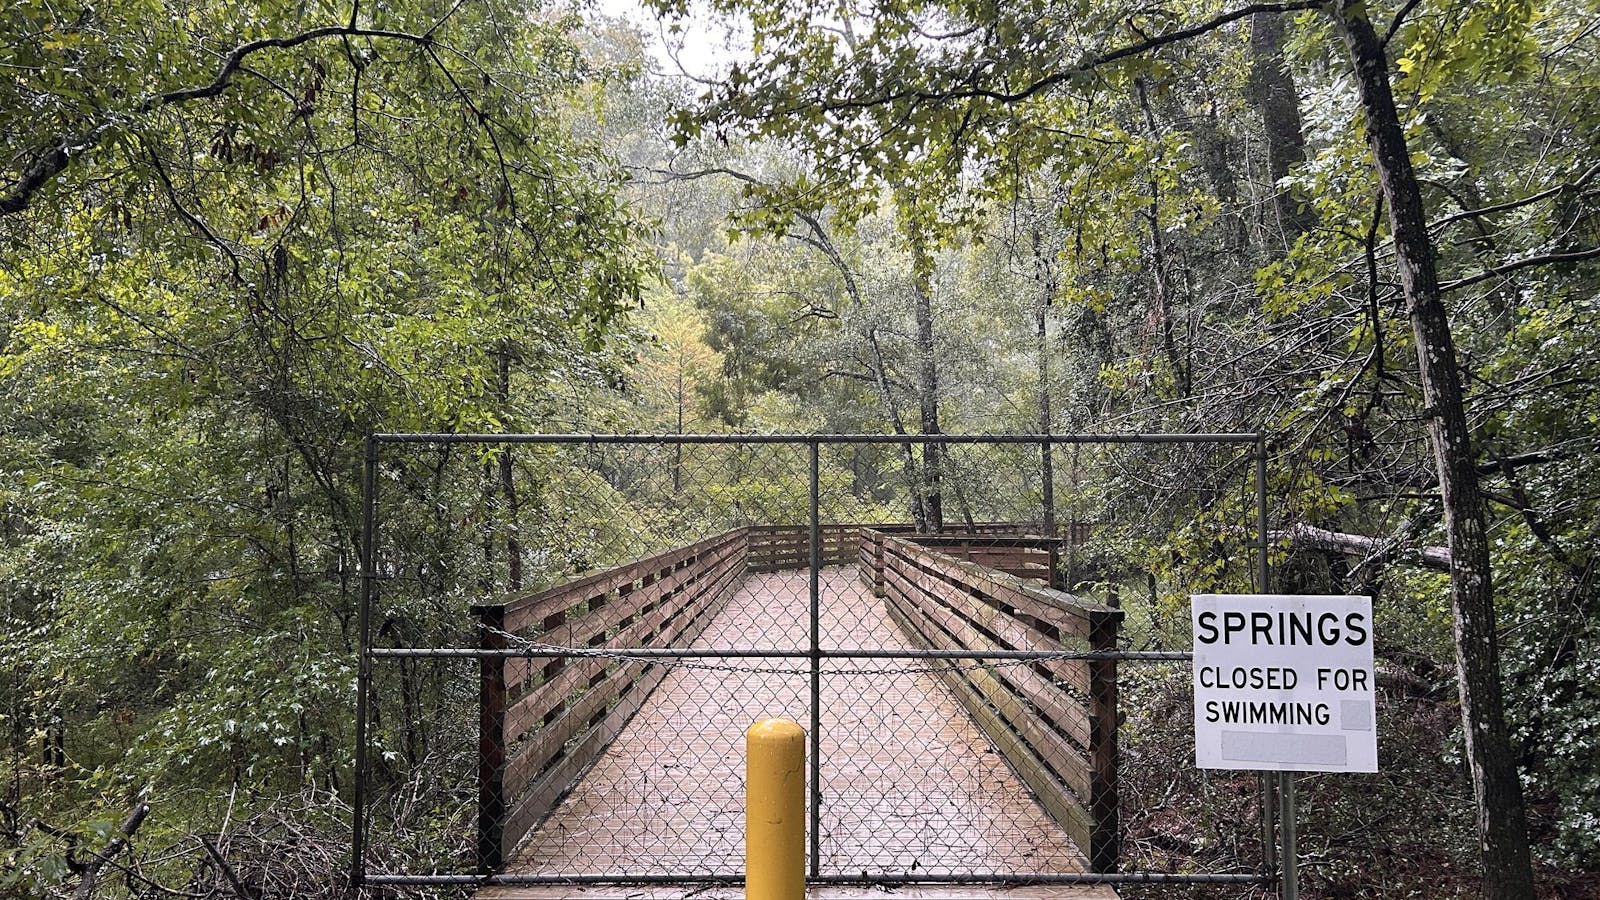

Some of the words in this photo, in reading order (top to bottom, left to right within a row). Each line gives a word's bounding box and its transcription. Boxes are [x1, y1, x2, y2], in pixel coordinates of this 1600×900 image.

[1197, 611, 1367, 646] SPRINGS
[1199, 666, 1298, 690] CLOSED
[1317, 668, 1368, 691] FOR
[1205, 701, 1330, 726] SWIMMING
